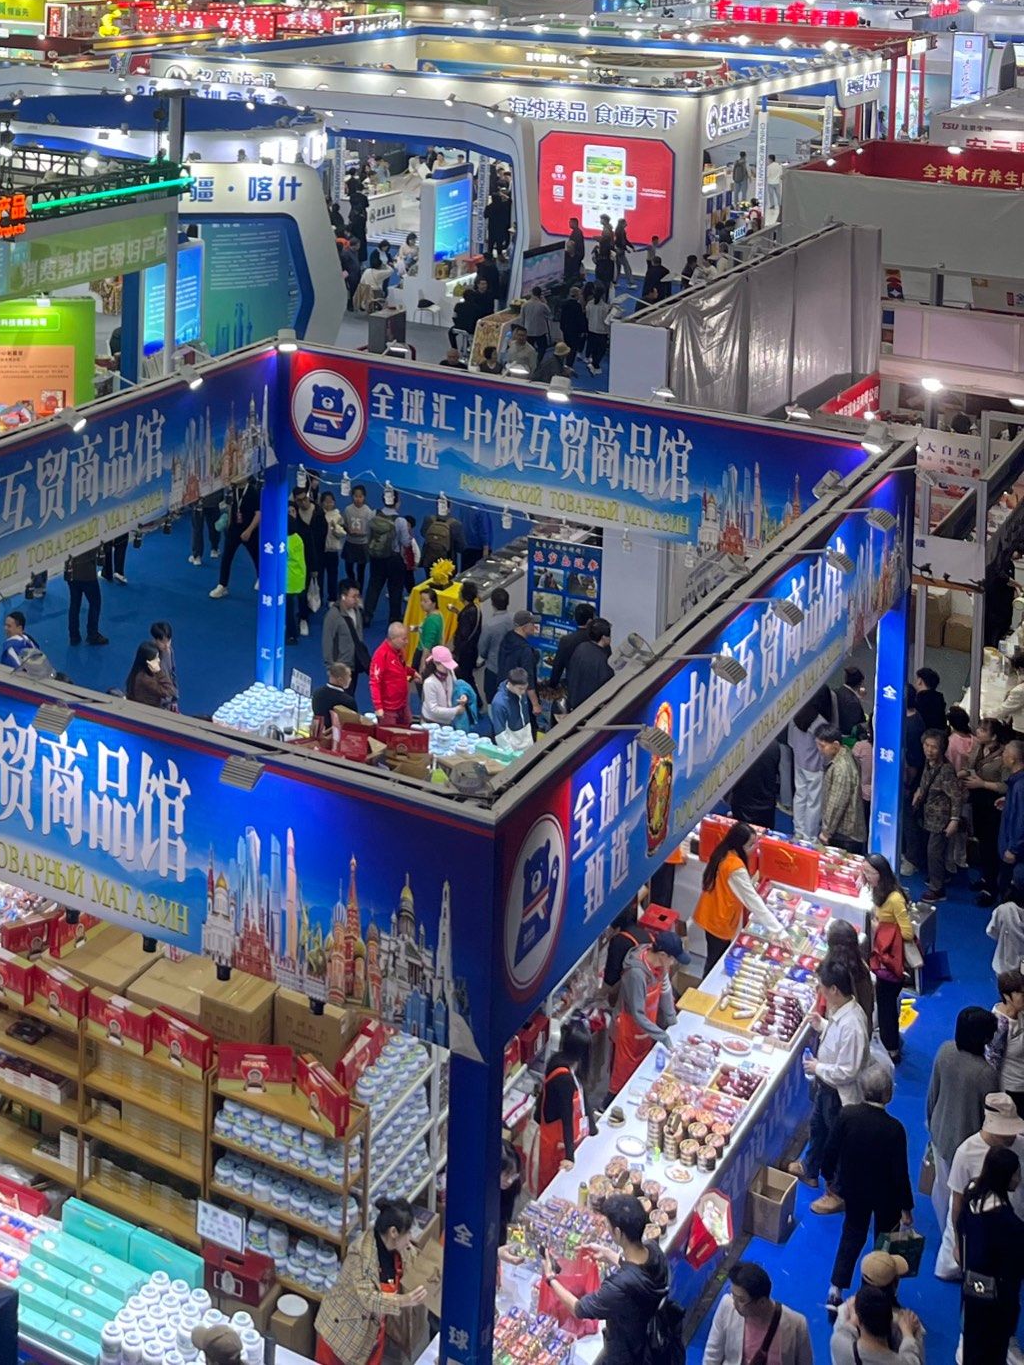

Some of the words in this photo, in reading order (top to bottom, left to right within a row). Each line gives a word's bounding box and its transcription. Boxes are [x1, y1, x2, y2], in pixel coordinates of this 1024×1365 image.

[509, 96, 588, 124] 海纳臻品
[594, 102, 678, 130] 食通天下
[371, 382, 456, 434] 全球汇
[384, 424, 440, 471] 甄选
[463, 394, 693, 504] 中俄互贸商品馆
[573, 739, 644, 862] 全球汇
[91, 869, 189, 935] МАГАЗИН
[583, 821, 630, 925] 甄选
